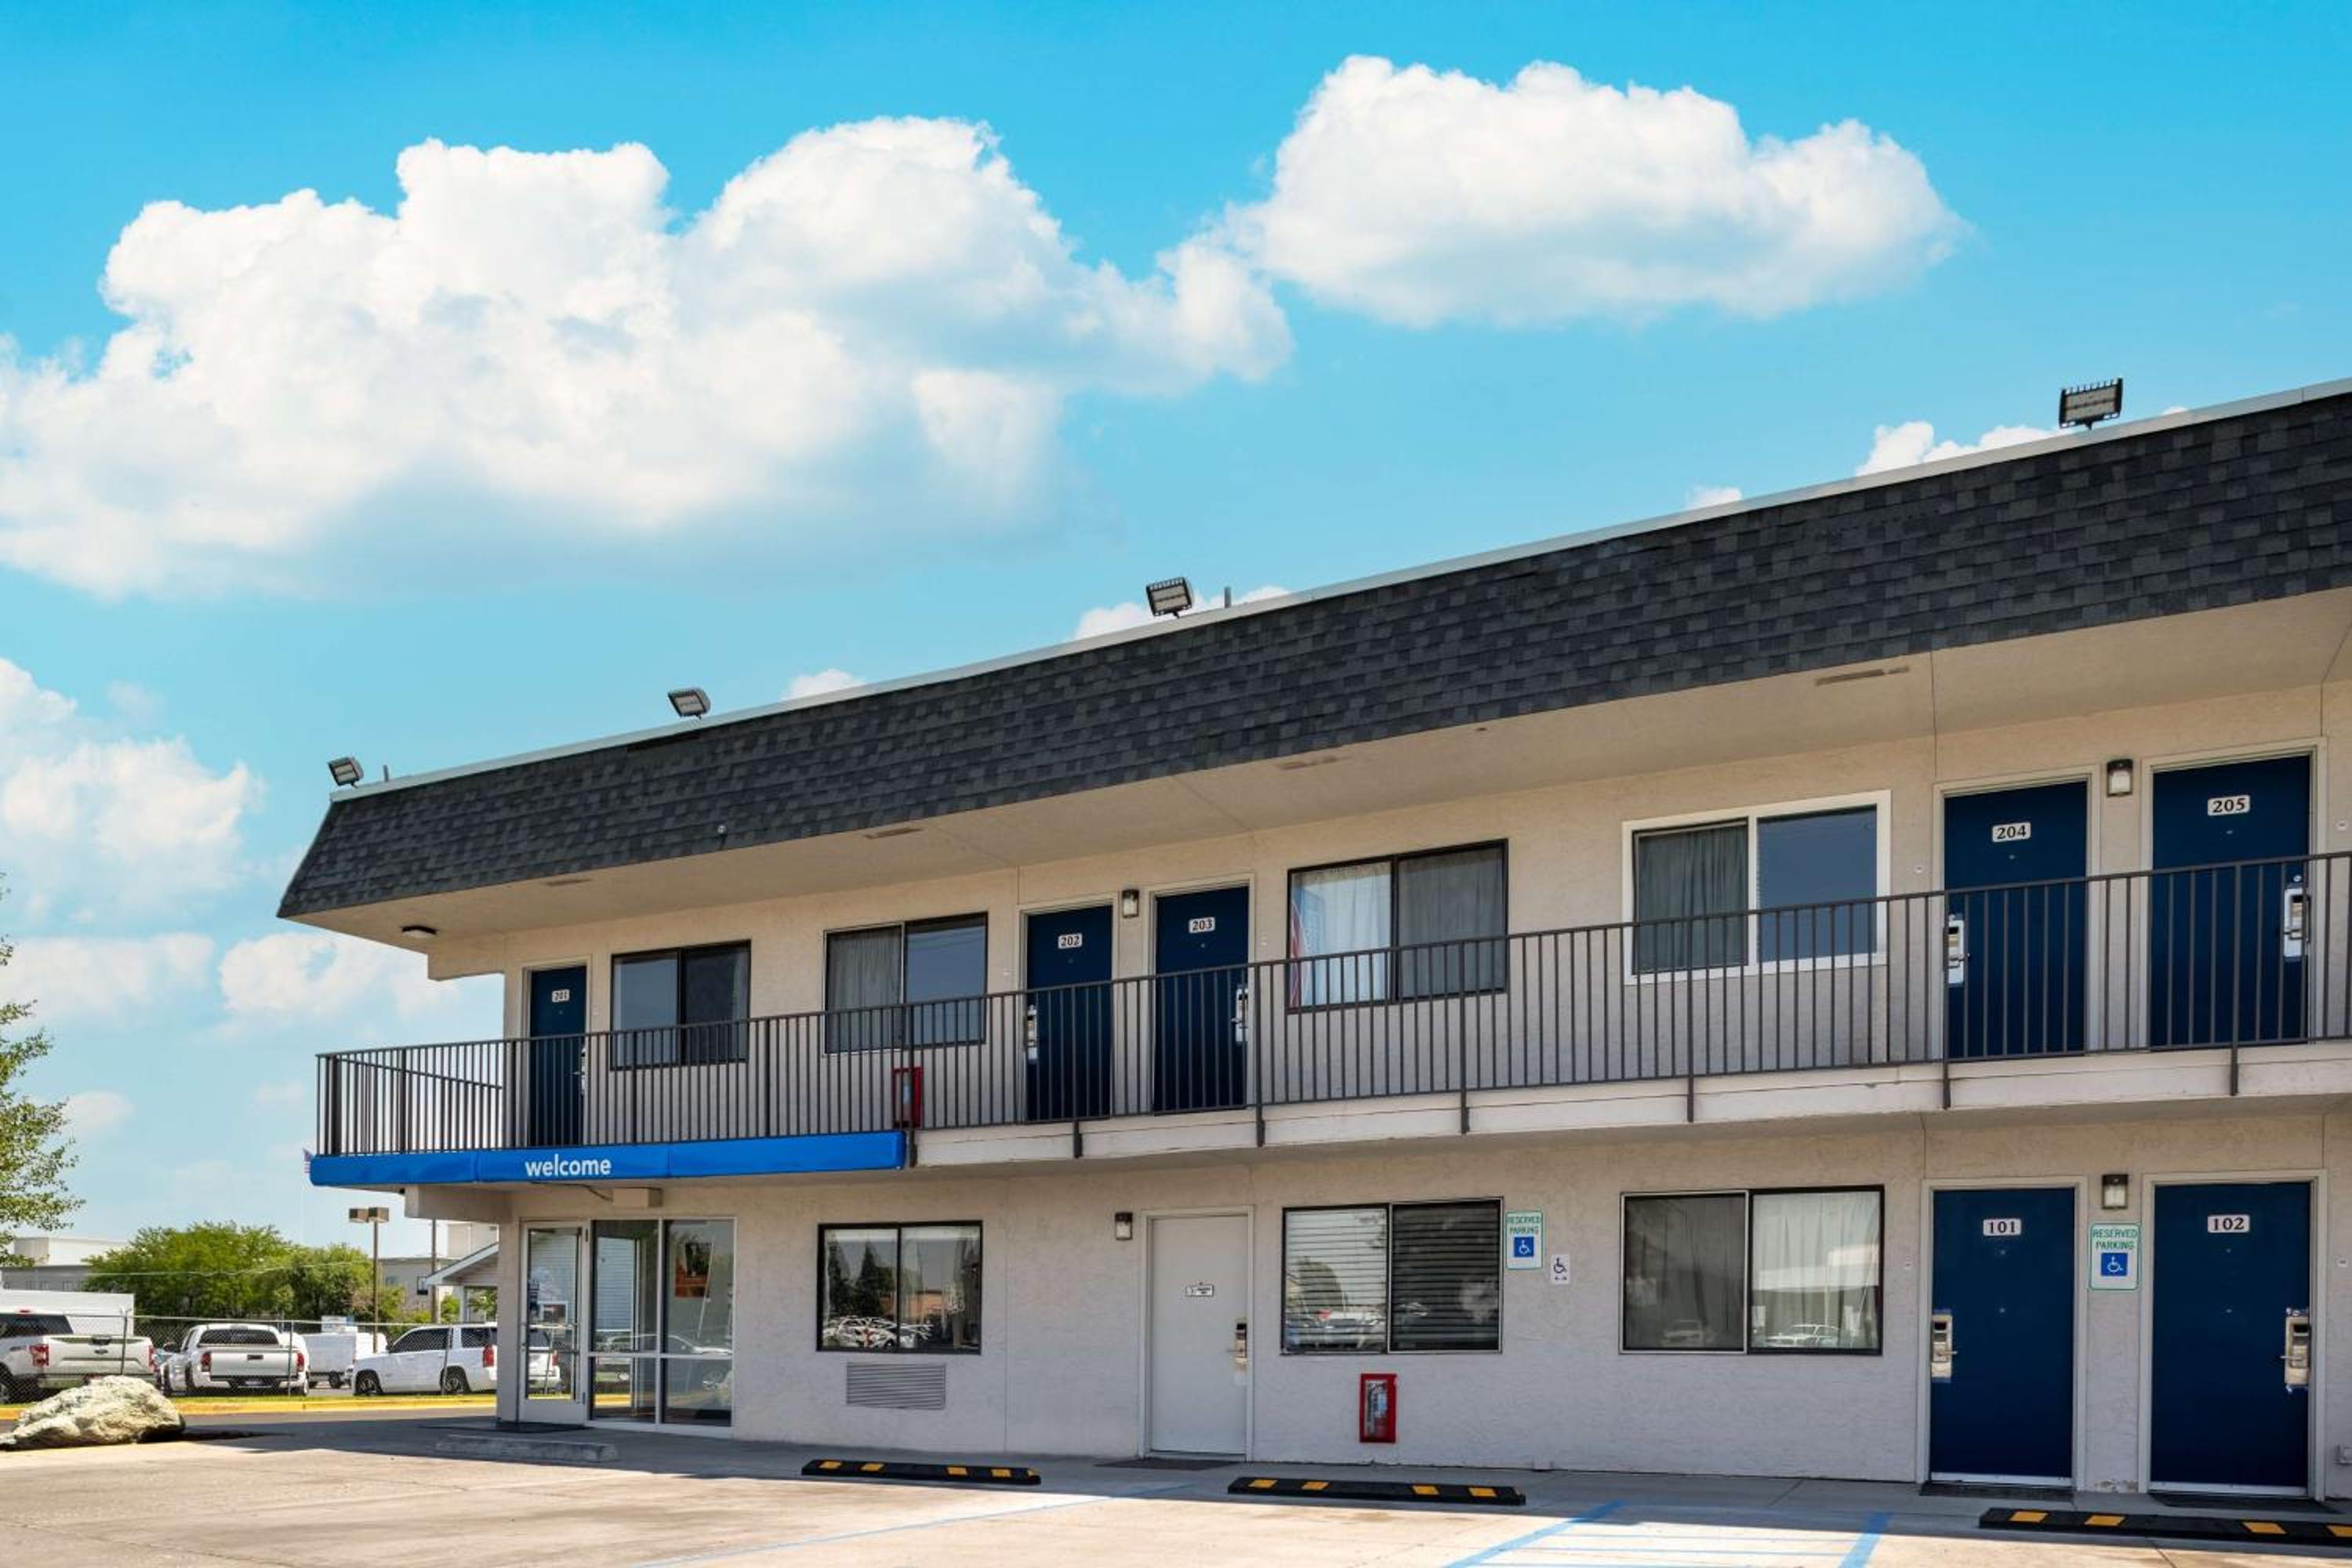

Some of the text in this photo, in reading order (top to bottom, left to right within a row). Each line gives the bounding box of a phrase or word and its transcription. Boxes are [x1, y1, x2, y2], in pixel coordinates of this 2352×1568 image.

[2212, 798, 2245, 813] 205
[1997, 825, 2027, 840] 204
[1192, 918, 1213, 931] 203
[1061, 935, 1080, 947] 202
[524, 1154, 612, 1177] welcome
[1507, 1215, 1541, 1224] RESERVED
[2213, 1217, 2245, 1231] 102
[1510, 1225, 1540, 1235] PARKING
[1989, 1221, 2016, 1233] 101
[2092, 1228, 2137, 1239] RESERVED
[2096, 1240, 2135, 1250] PARKING
